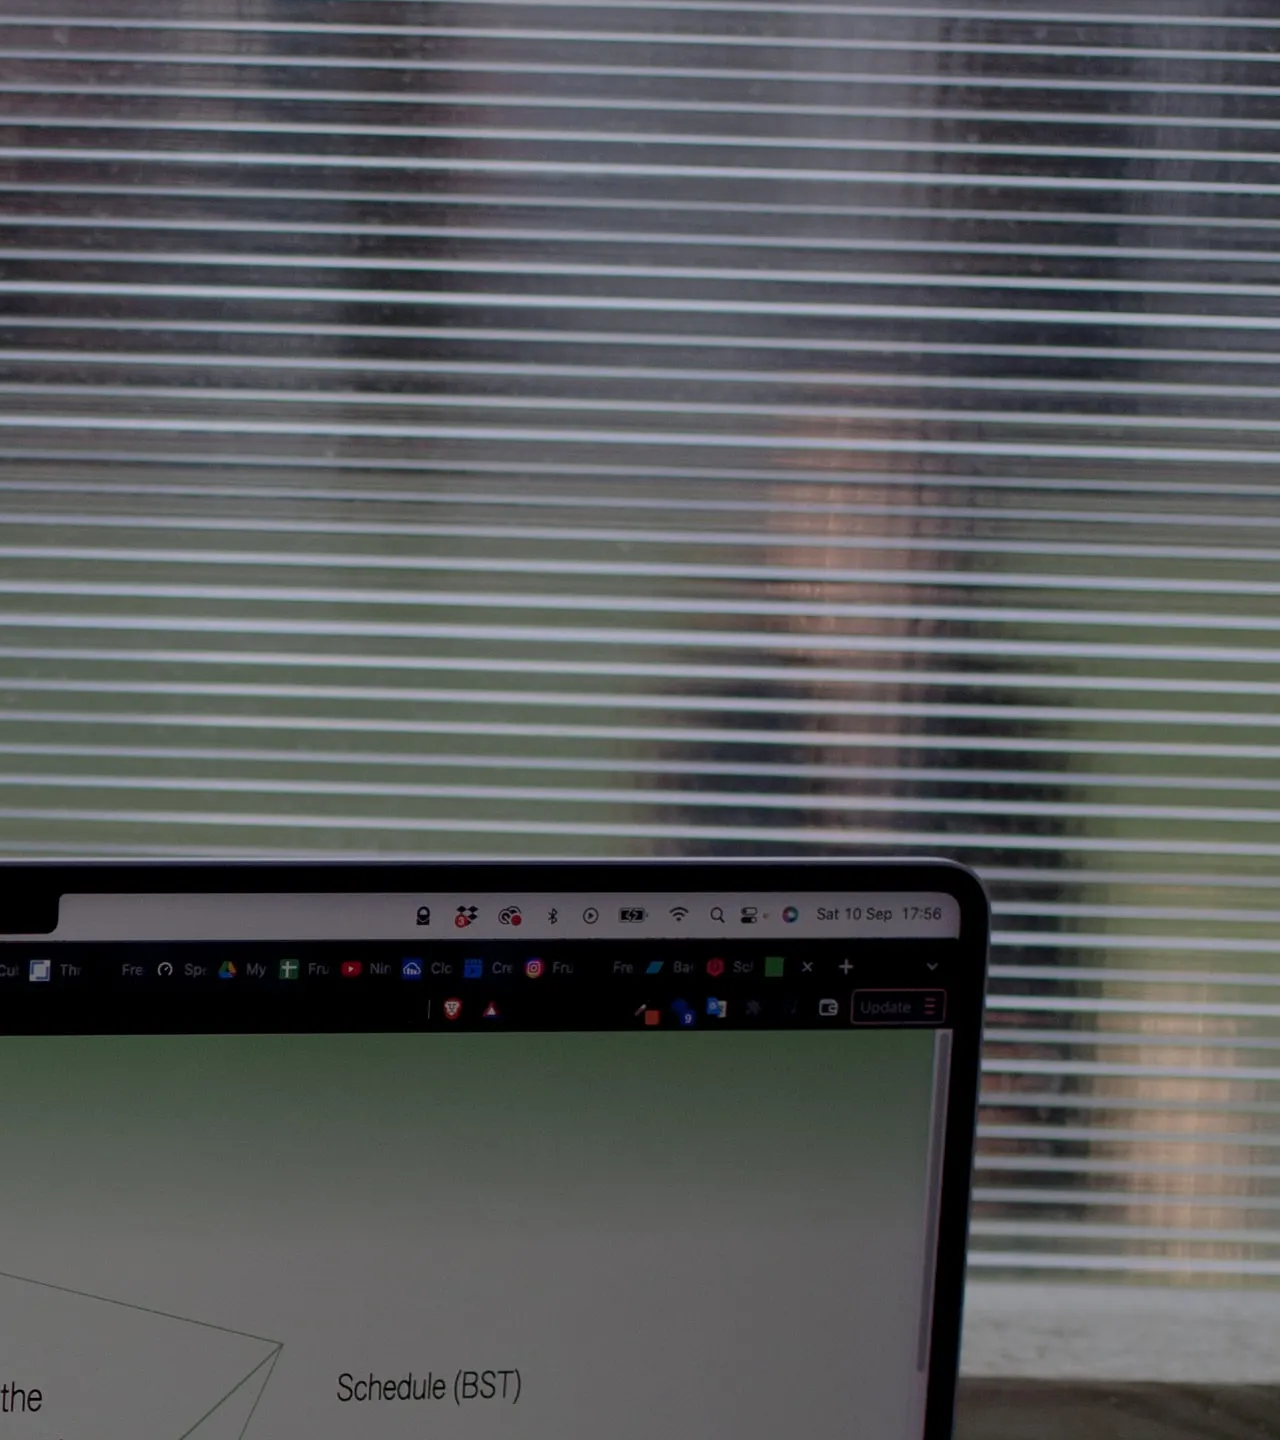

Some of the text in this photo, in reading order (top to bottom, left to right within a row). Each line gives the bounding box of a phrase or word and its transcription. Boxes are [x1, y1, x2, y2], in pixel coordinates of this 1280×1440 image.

[816, 906, 840, 921] Sat
[844, 906, 862, 921] 10
[866, 906, 893, 923] Sep
[246, 963, 268, 979] My
[860, 1000, 912, 1017] Update
[336, 1368, 522, 1406] Schedule (BST)
[0, 1380, 43, 1413] the
